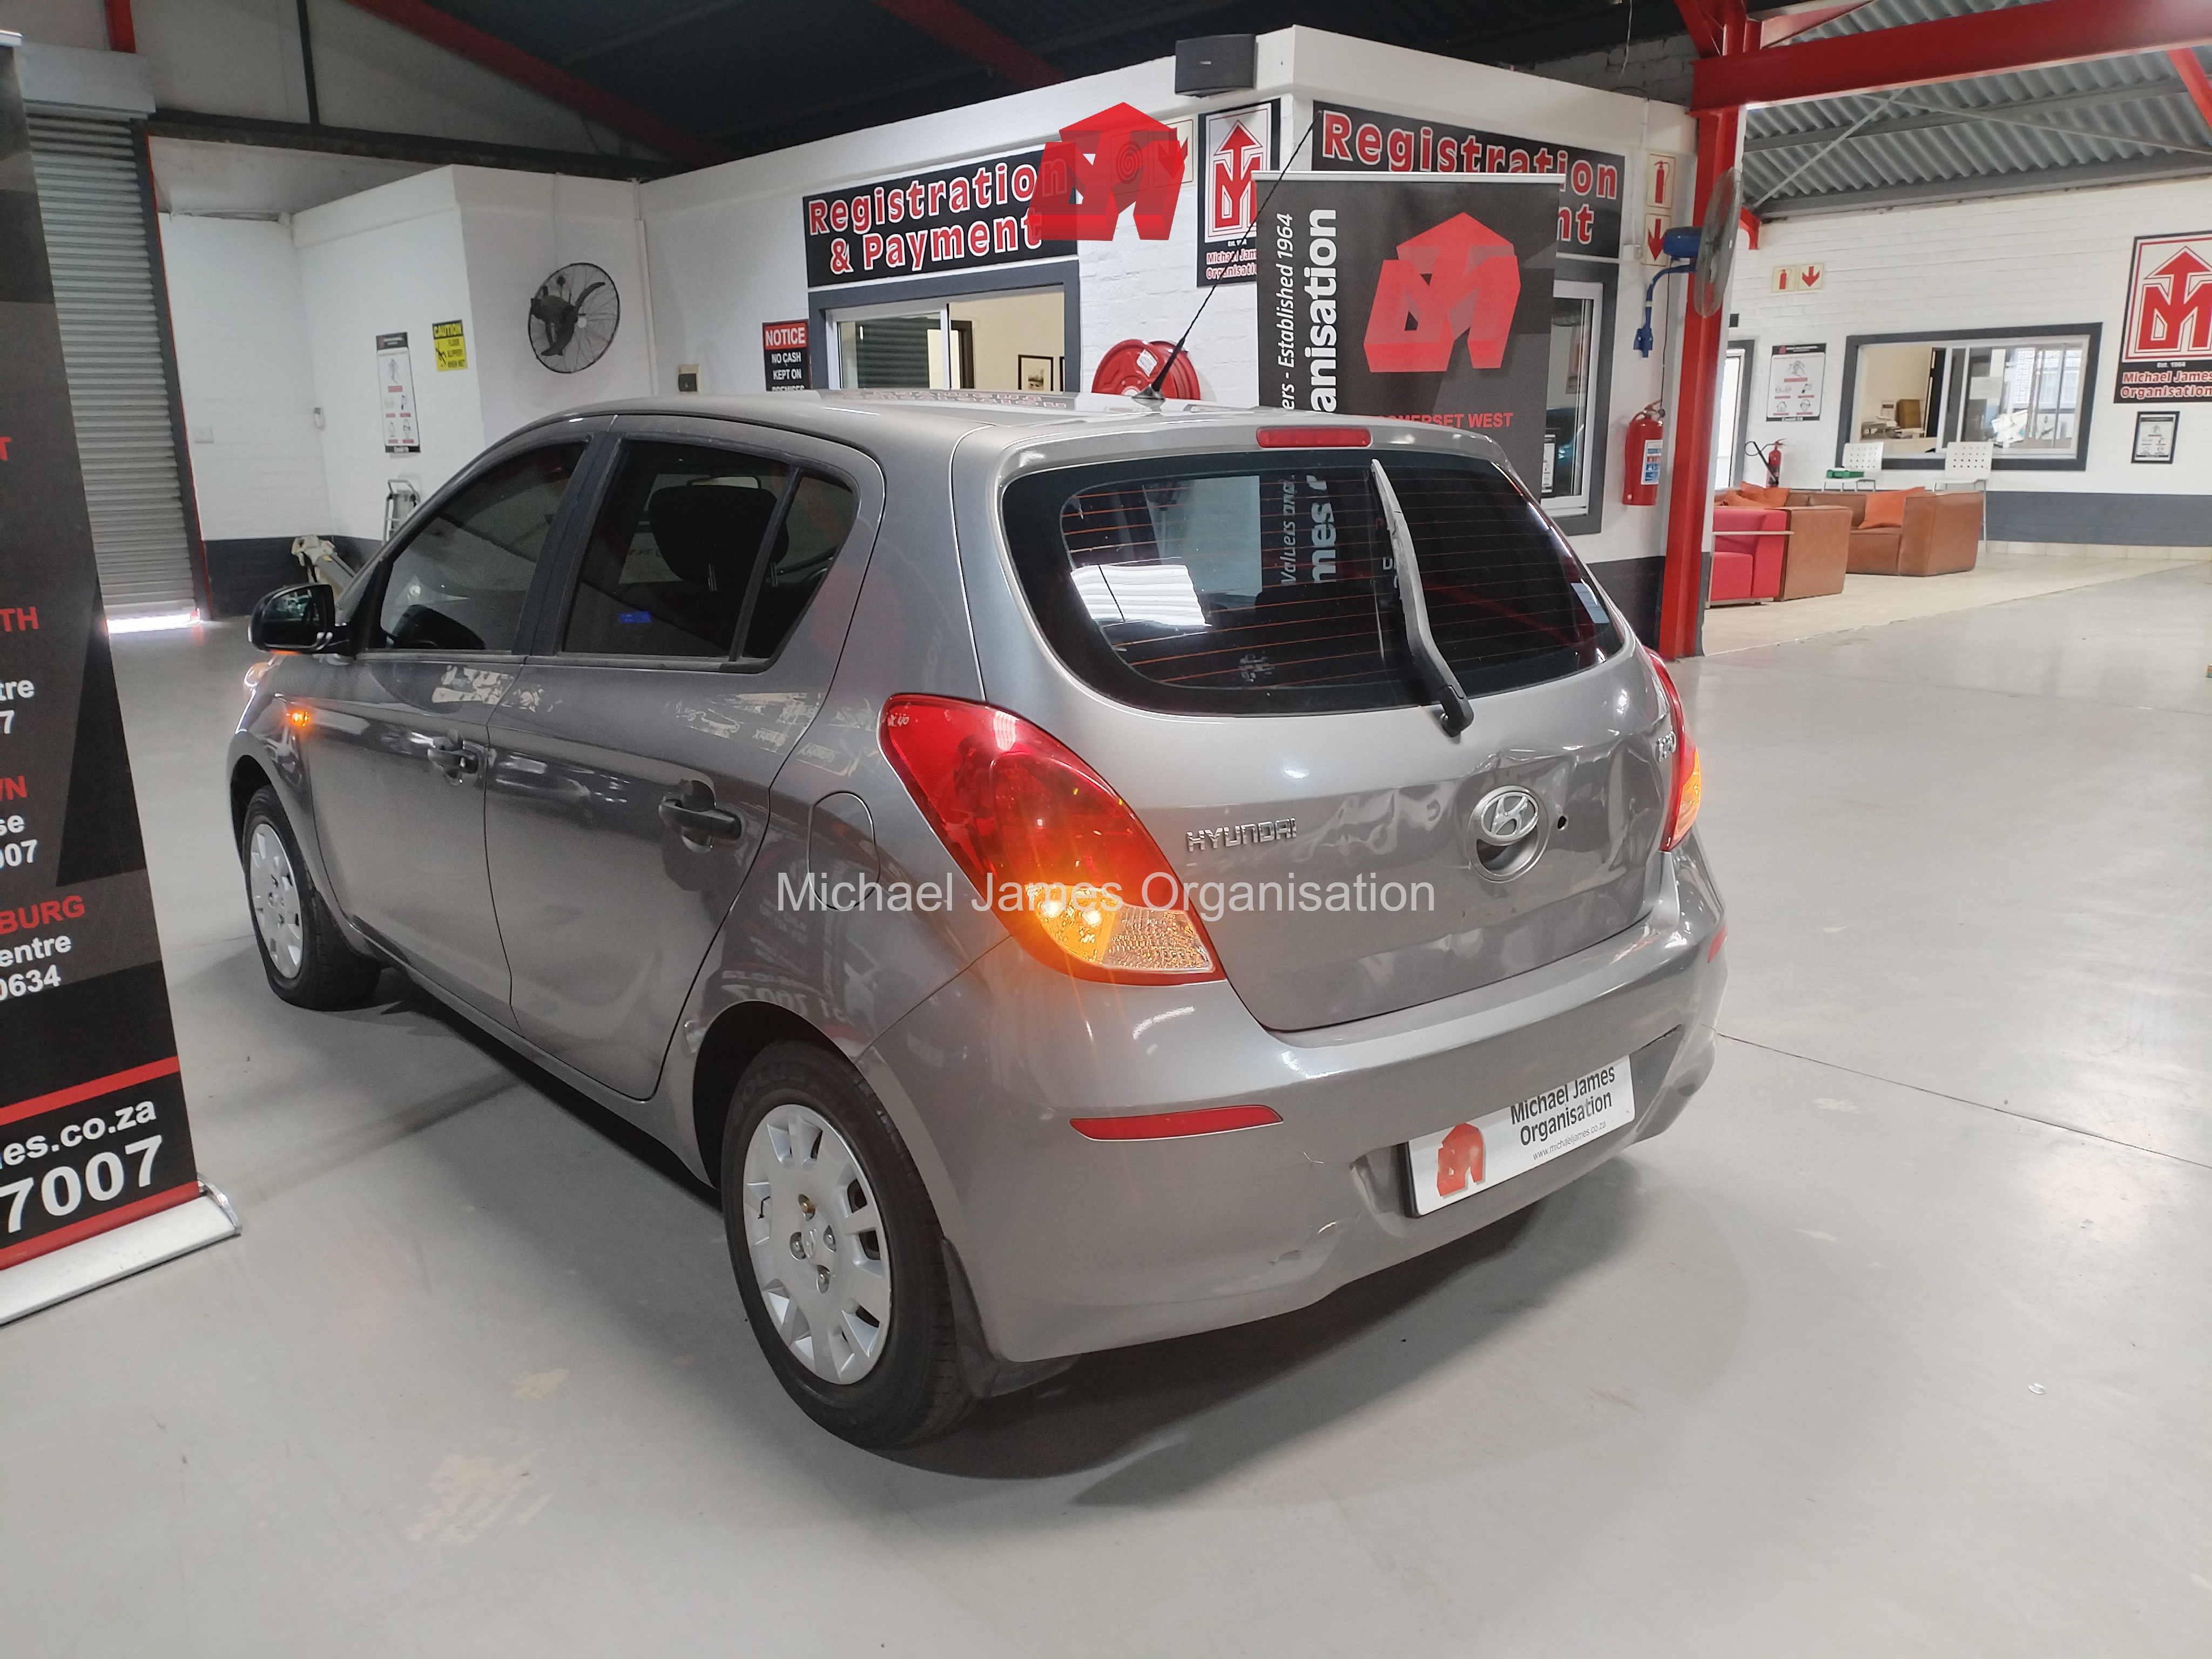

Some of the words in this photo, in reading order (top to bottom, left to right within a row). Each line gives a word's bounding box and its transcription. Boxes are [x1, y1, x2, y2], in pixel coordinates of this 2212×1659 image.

[1322, 110, 1618, 200] Registration
[808, 158, 1068, 235] Registration
[831, 238, 854, 274] &
[863, 207, 1042, 271] Payment
[1276, 213, 1293, 259] 1964
[1276, 263, 1294, 369] Established
[1304, 209, 1338, 414] anisation
[765, 327, 806, 346] NOTICE
[771, 353, 782, 363] NO
[783, 352, 801, 363] CASH
[772, 369, 790, 380] KEPT
[791, 368, 802, 379] ON
[2122, 370, 2173, 384] Michael
[2173, 370, 2212, 382] James
[2120, 385, 2212, 400] Organisation
[1380, 413, 1464, 429] RSET
[1467, 412, 1513, 428] WEST
[0, 775, 28, 802] N
[0, 839, 37, 869] 07
[1187, 817, 1297, 852] HYUNDAI
[0, 895, 85, 934] BURG
[1510, 1084, 1569, 1125] Michael
[1573, 1066, 1615, 1099] James
[0, 1100, 157, 1170] es.co.za
[1520, 1092, 1612, 1146] Organisation
[1533, 1121, 1607, 1160] www.michaeljames.co.za
[0, 1134, 163, 1233] 7007
